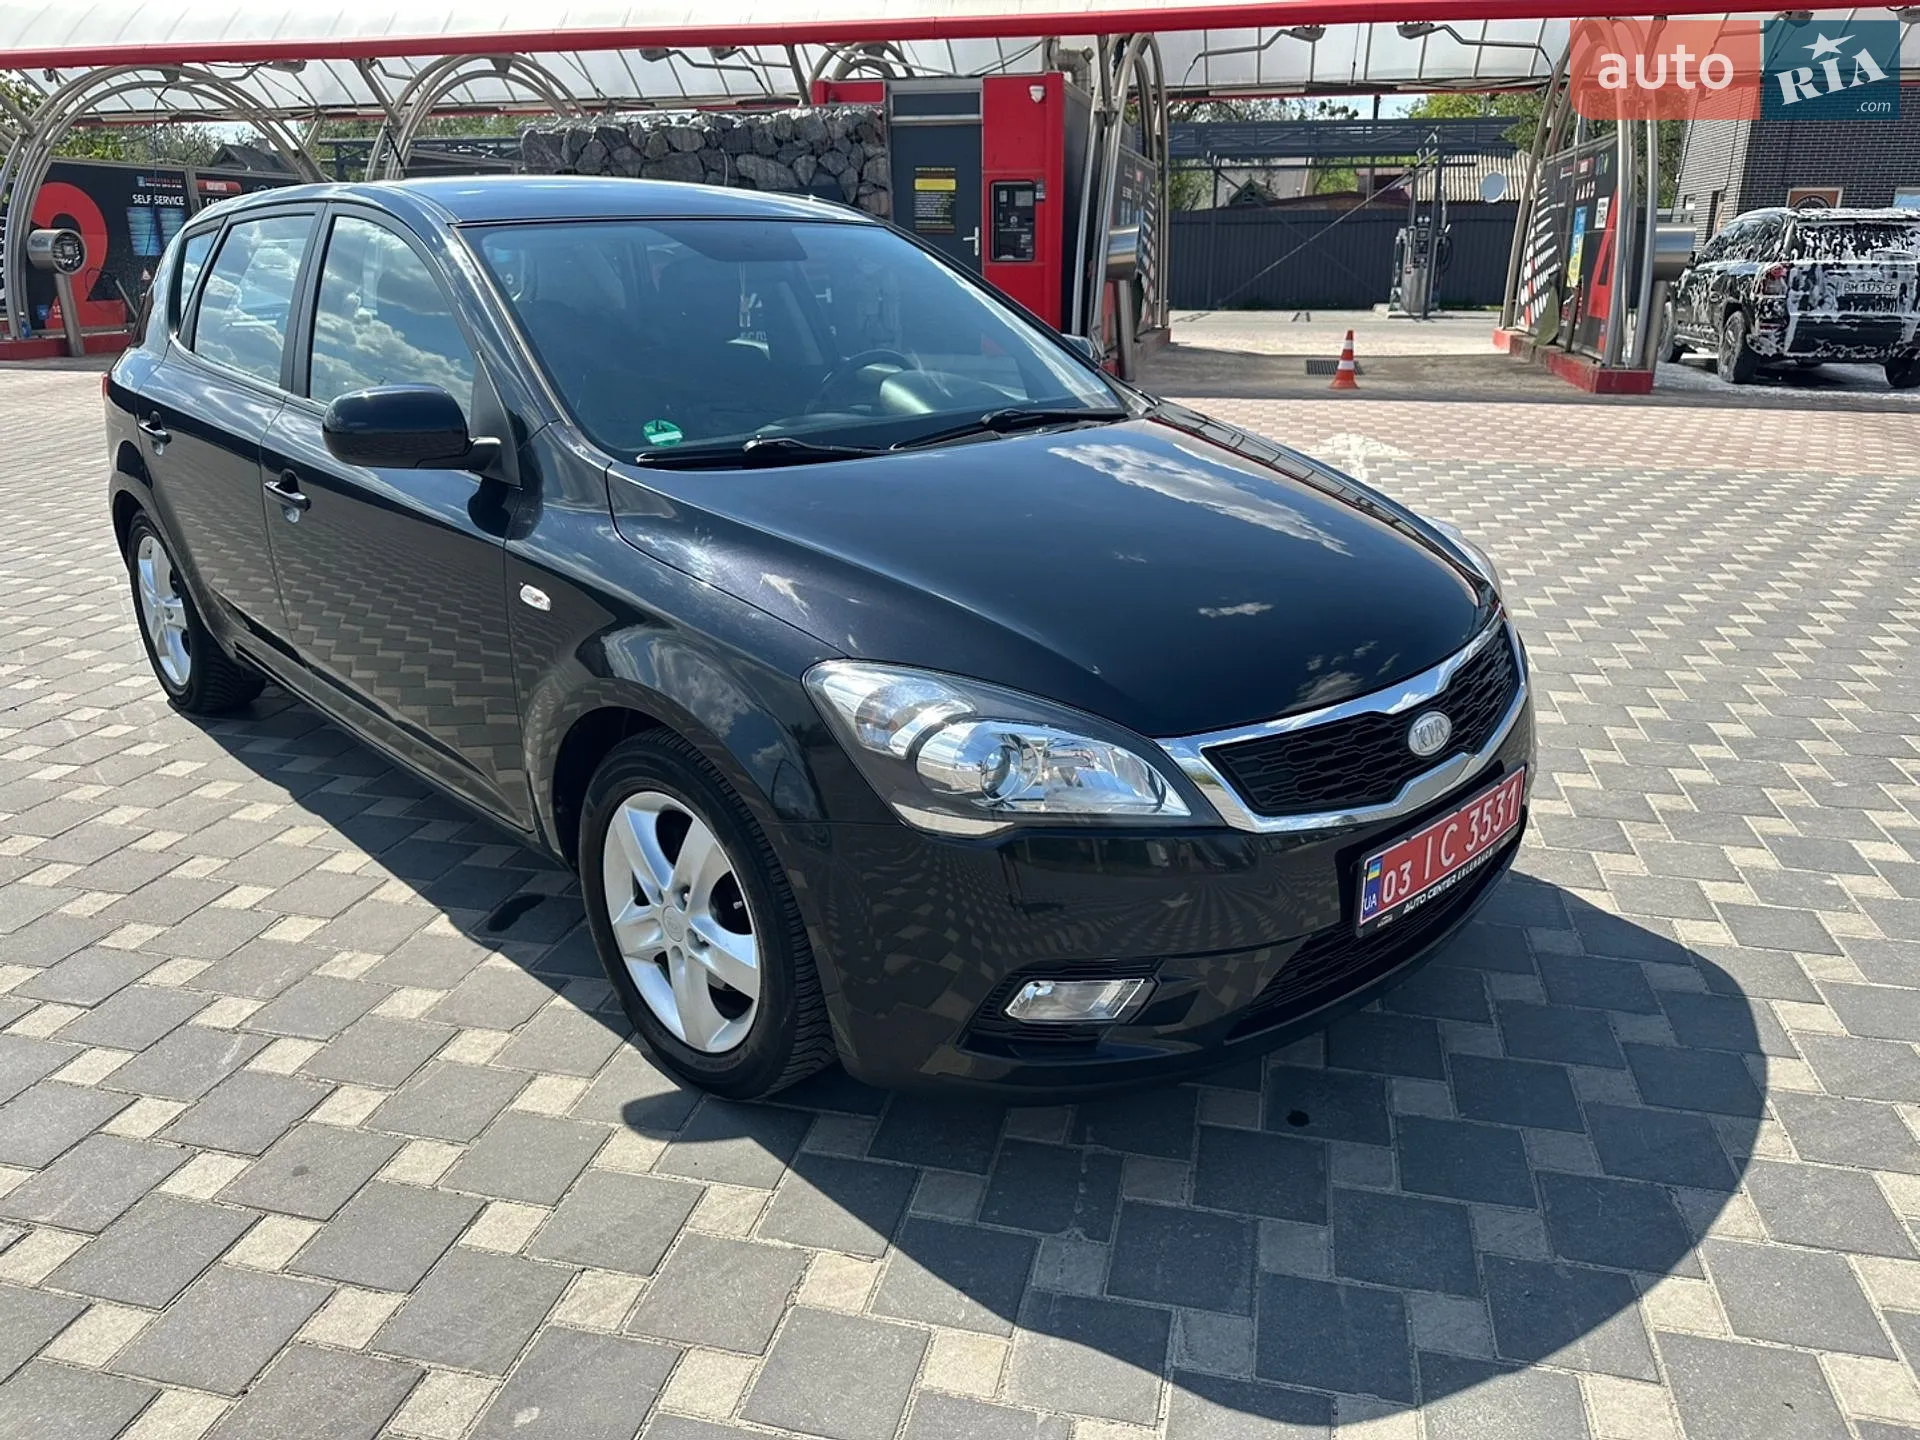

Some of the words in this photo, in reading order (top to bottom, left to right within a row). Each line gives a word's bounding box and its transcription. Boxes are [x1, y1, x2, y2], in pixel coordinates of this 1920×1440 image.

[132, 194, 151, 204] SELF
[154, 195, 185, 206] SERVICE
[1382, 860, 1412, 904] 03
[1465, 781, 1517, 853] 3531
[1364, 895, 1378, 911] UA
[1403, 894, 1427, 915] AUTO
